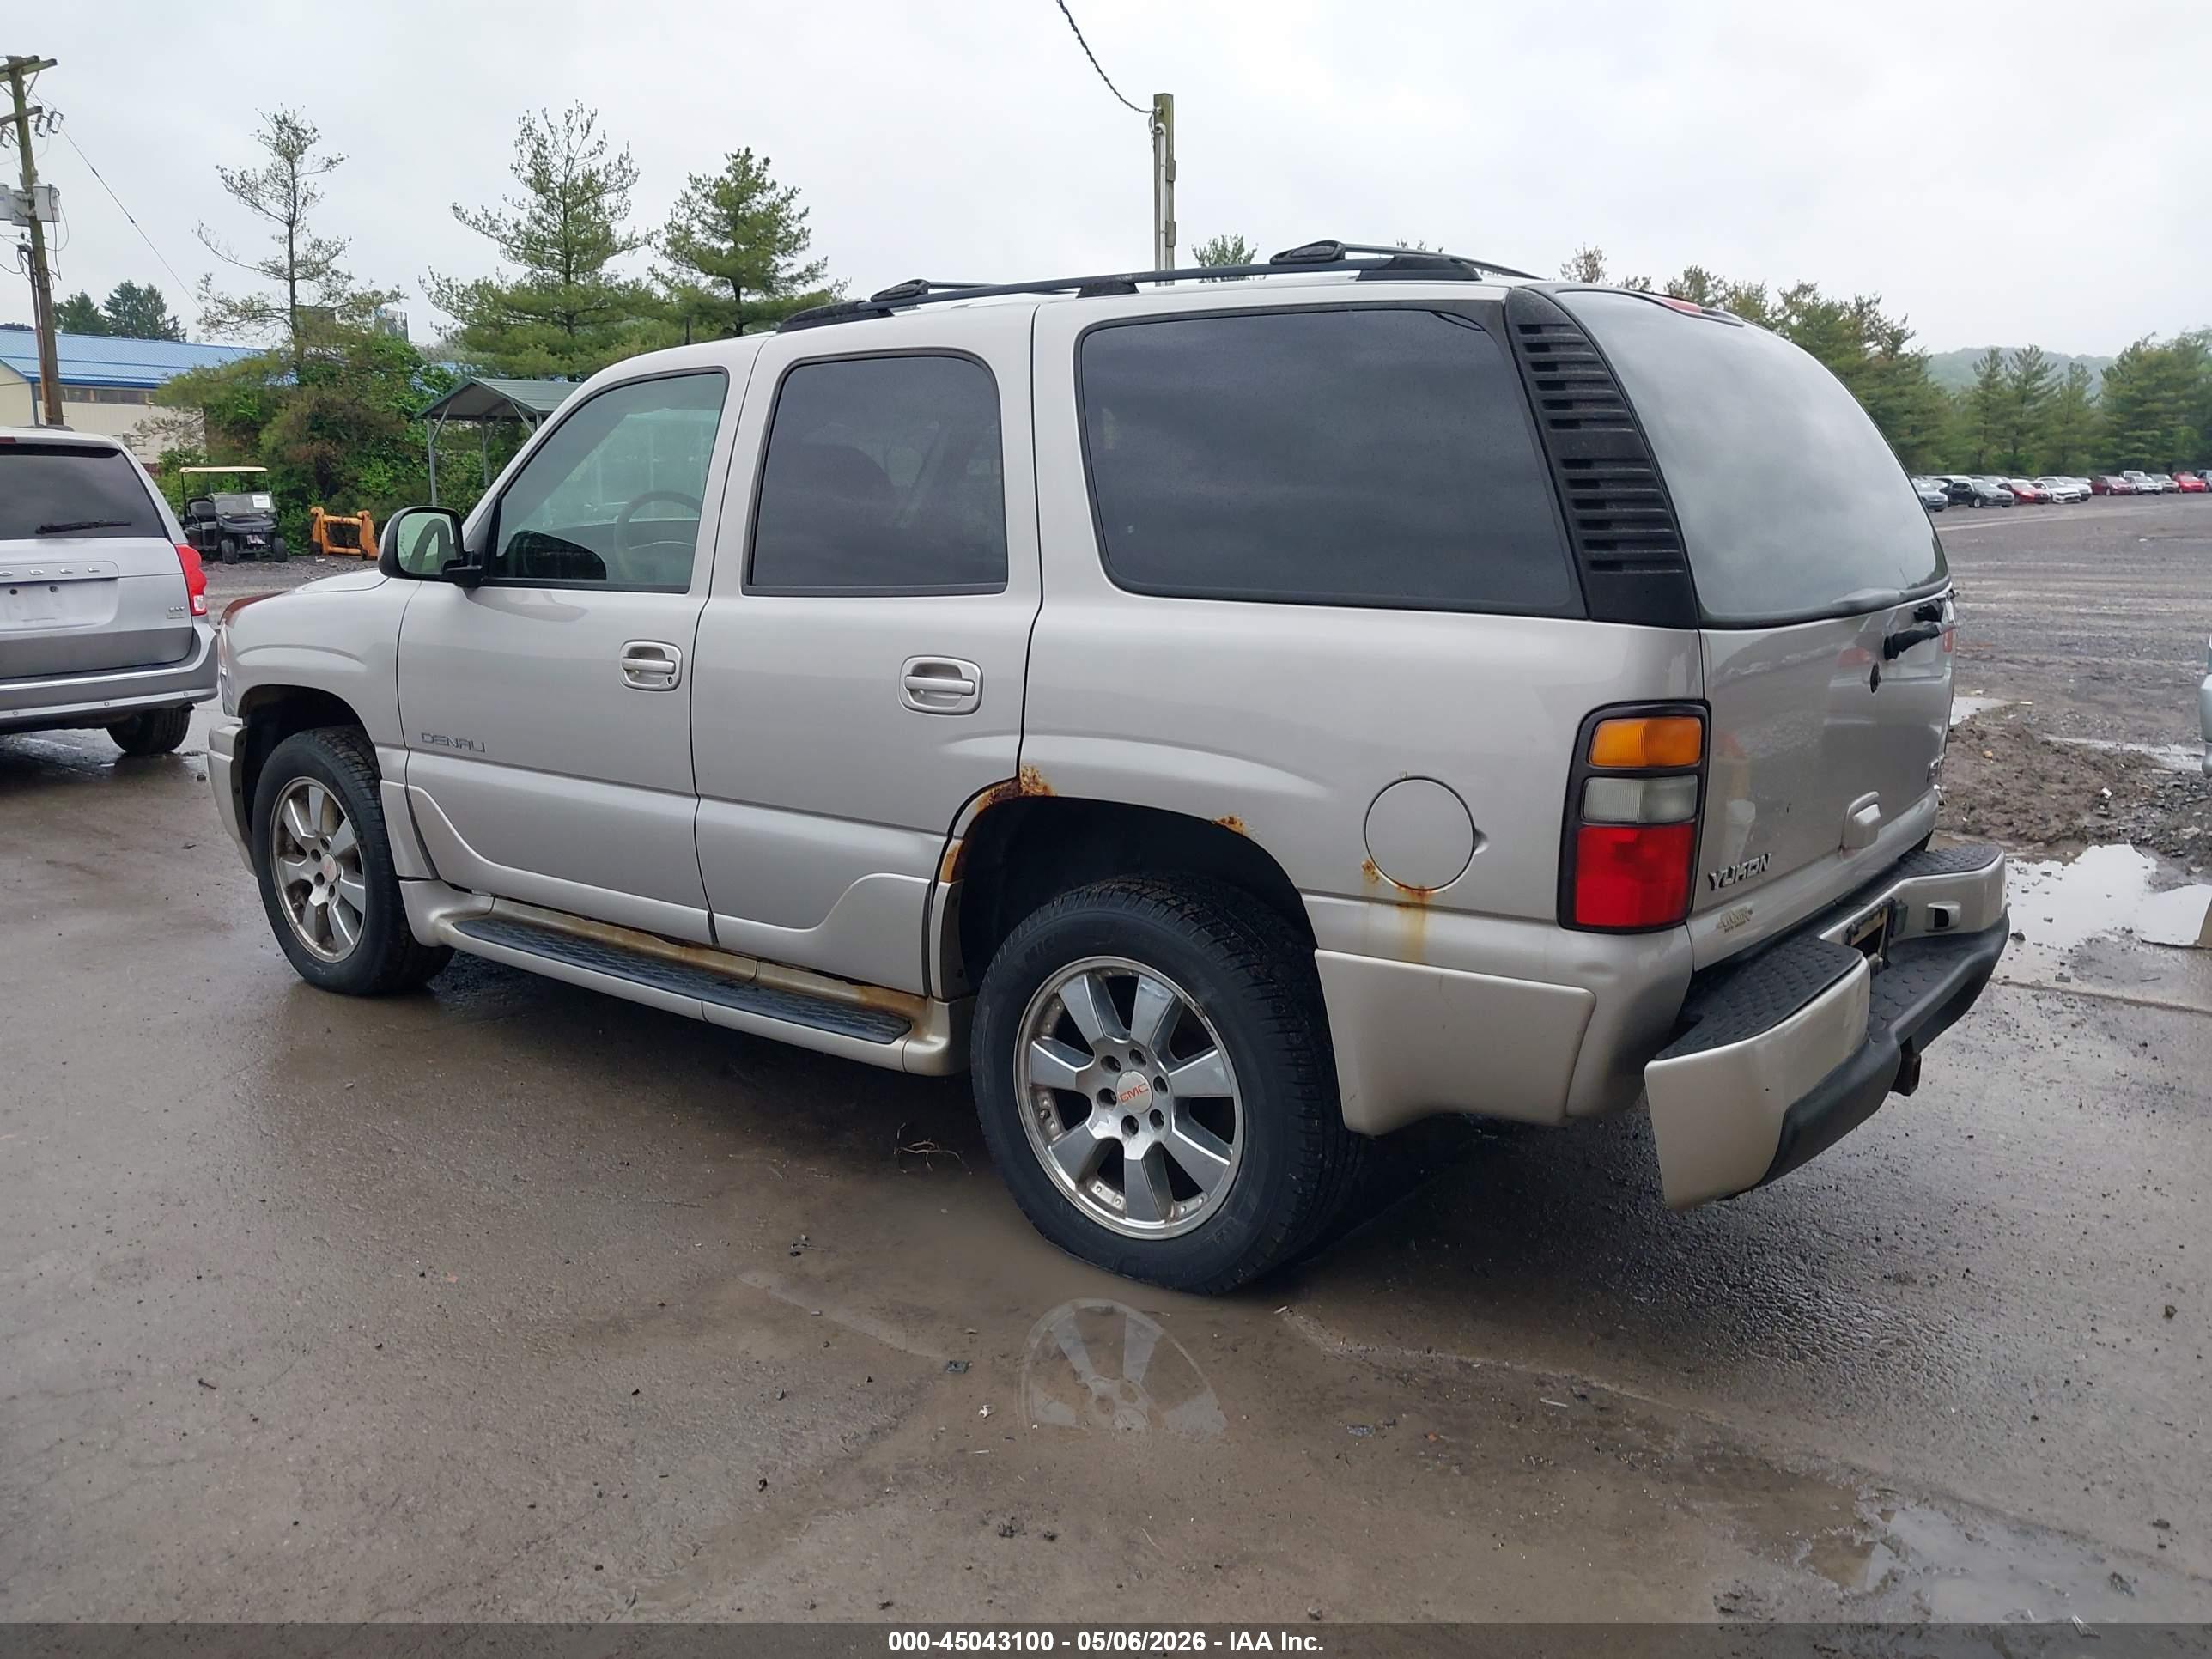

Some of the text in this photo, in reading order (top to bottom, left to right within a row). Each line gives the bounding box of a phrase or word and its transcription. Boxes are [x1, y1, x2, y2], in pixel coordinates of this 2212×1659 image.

[421, 732, 486, 753] DENALI
[1707, 852, 1771, 891] YUKON
[1119, 1082, 1149, 1103] GMC
